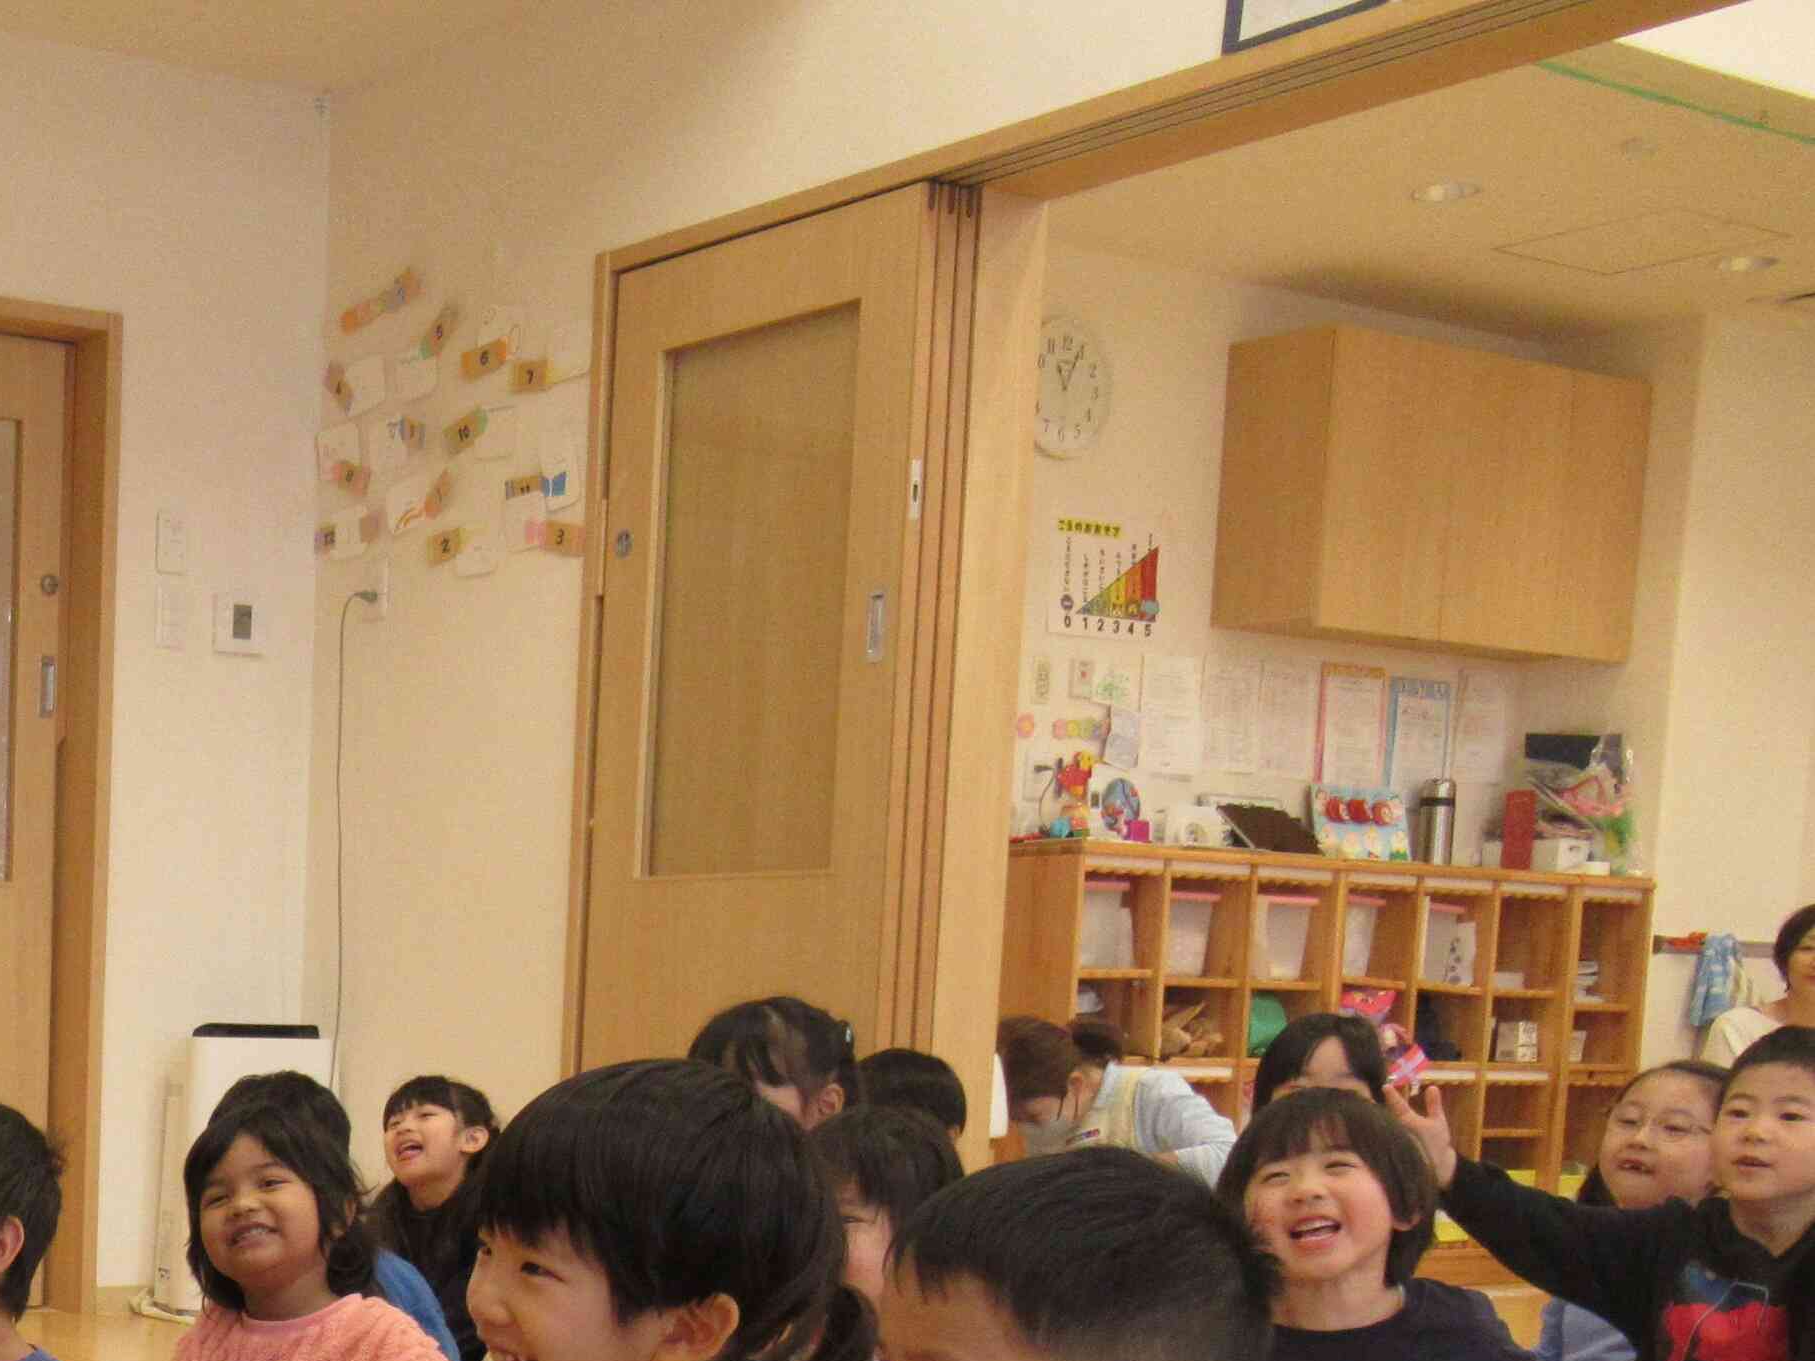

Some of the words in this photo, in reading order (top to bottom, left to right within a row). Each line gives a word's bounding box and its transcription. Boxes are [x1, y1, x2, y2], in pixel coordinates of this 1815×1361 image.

[555, 527, 565, 545] 3
[1064, 615, 1072, 628] 0
[1082, 617, 1088, 630] 1
[1097, 618, 1105, 632] 2
[1112, 619, 1121, 634] 3
[1127, 621, 1135, 635] 4
[1145, 623, 1152, 637] 5
